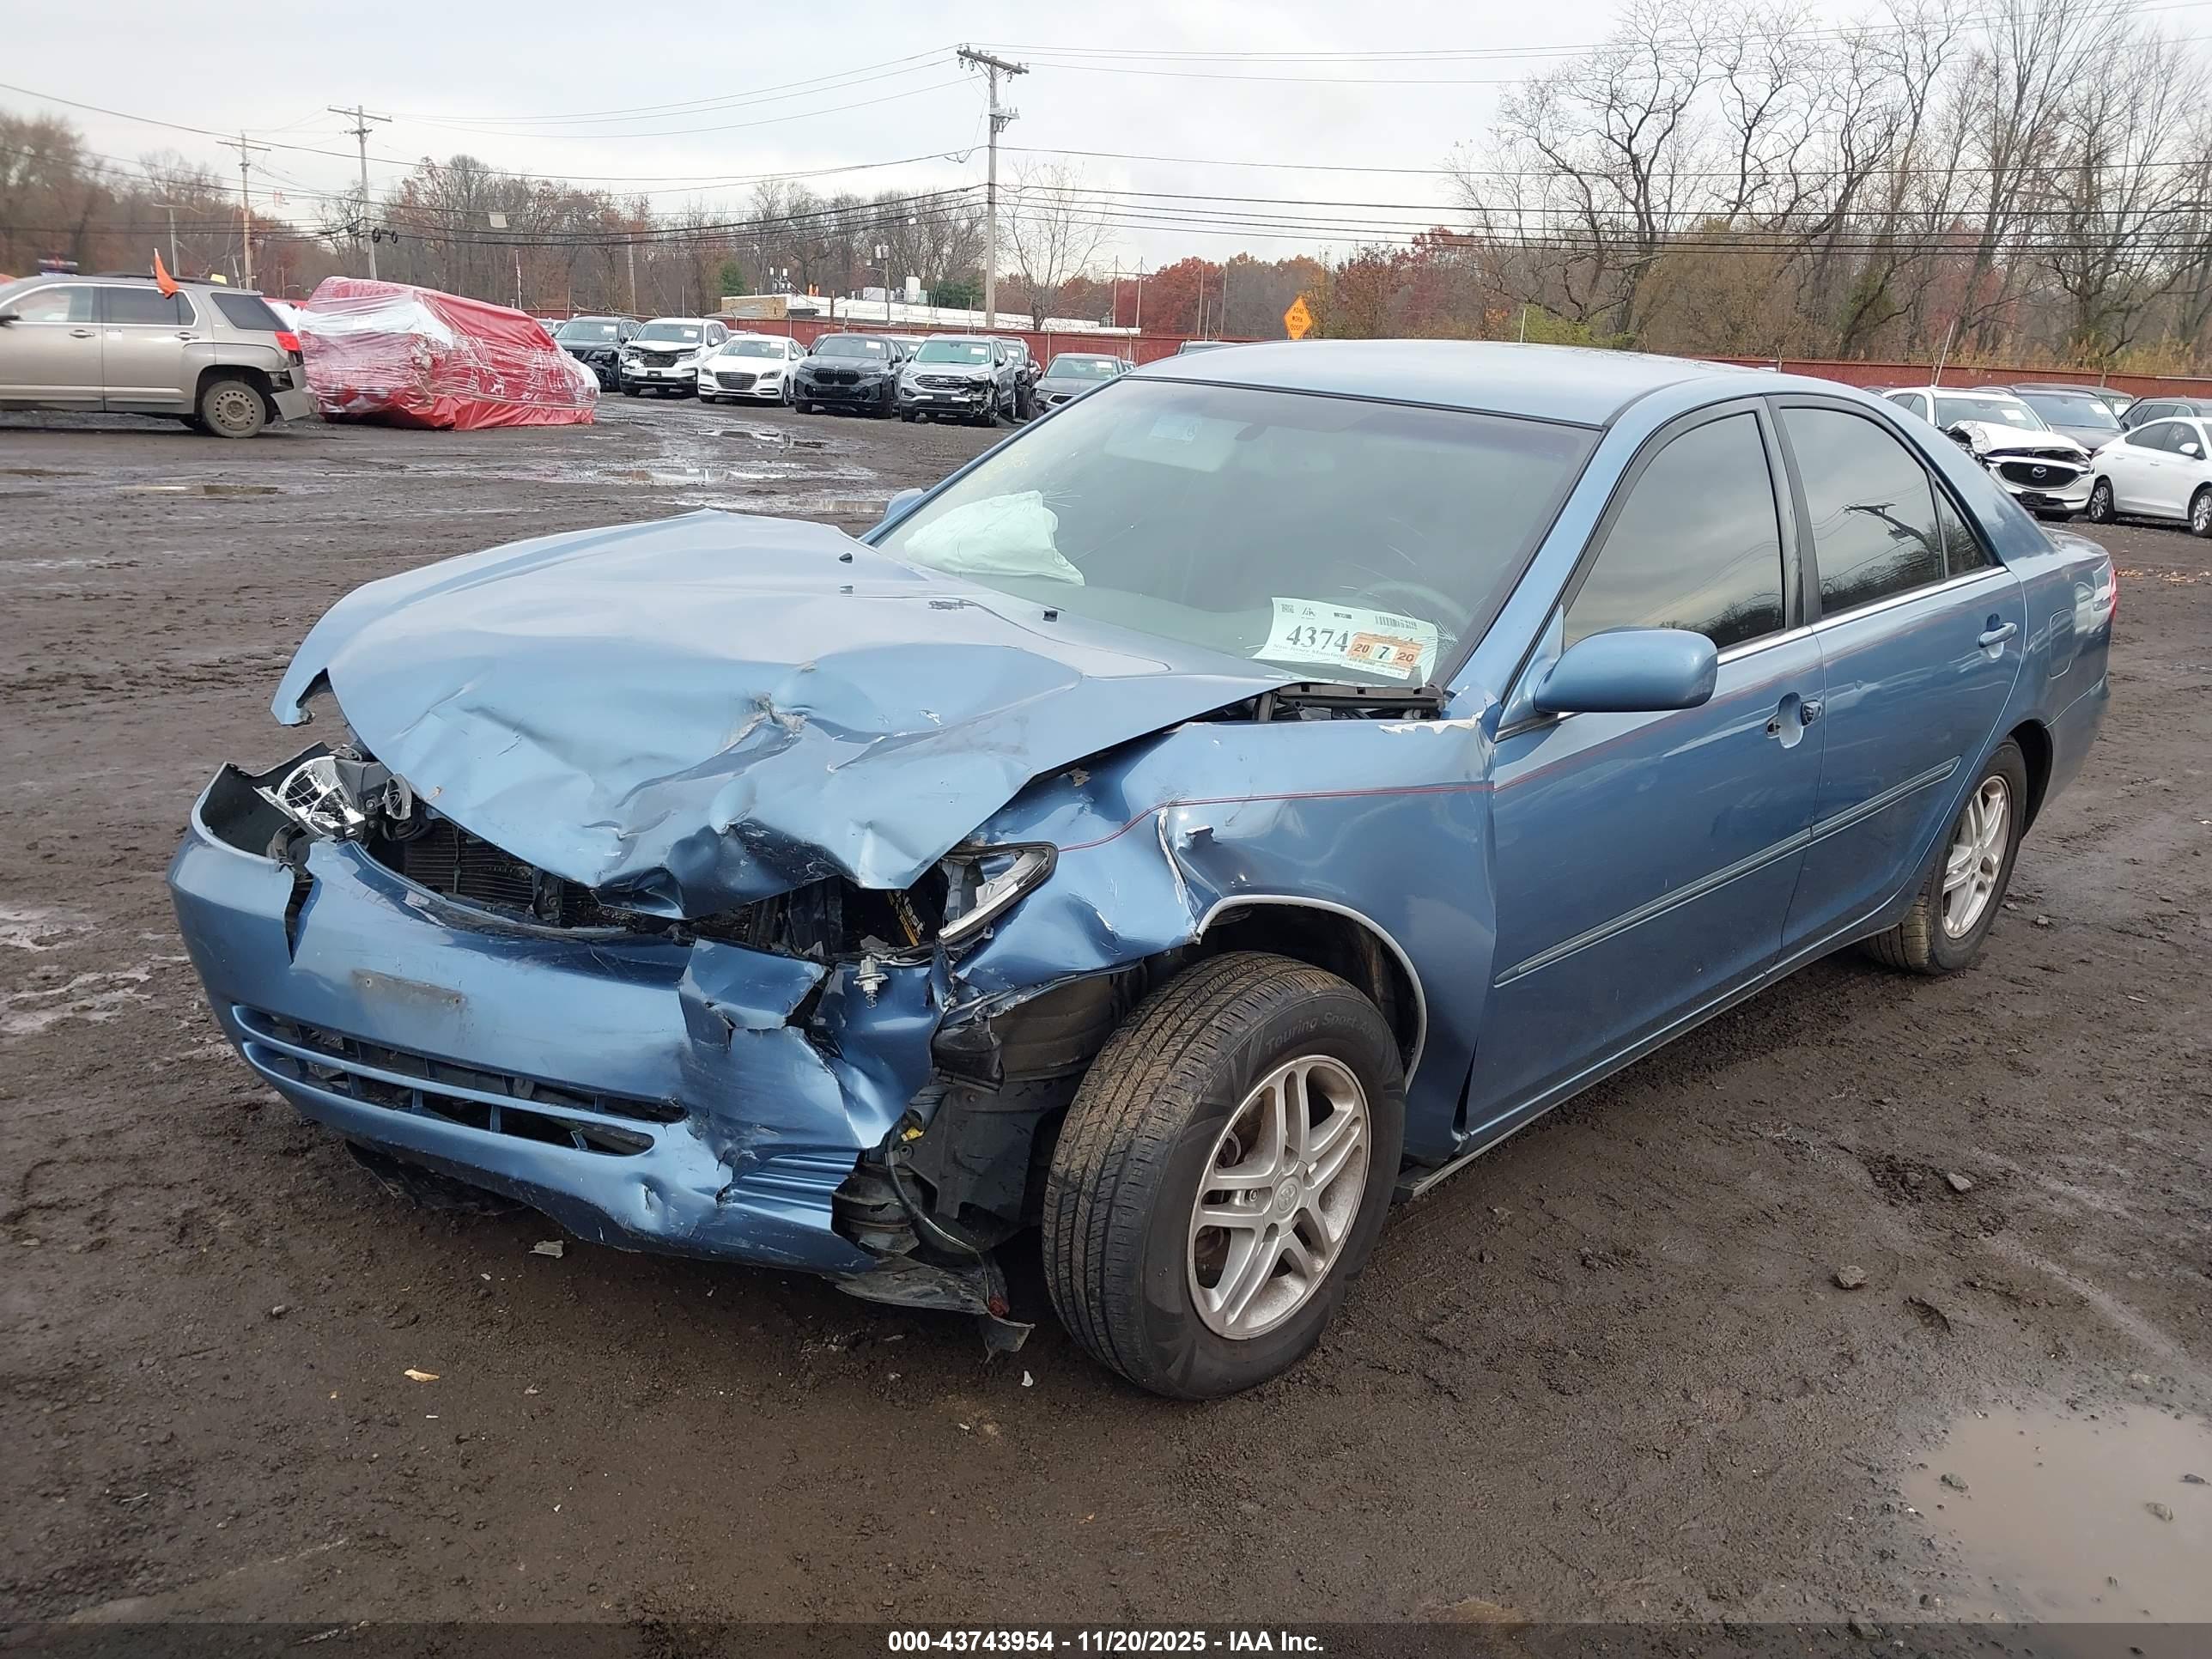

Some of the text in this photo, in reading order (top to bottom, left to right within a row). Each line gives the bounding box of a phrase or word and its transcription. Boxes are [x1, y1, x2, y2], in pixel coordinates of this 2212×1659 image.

[1353, 643, 1370, 653] 20
[1377, 646, 1390, 659] 7
[1396, 652, 1415, 663] 20
[1266, 1017, 1319, 1054] Touring
[1322, 1011, 1358, 1029] Sport
